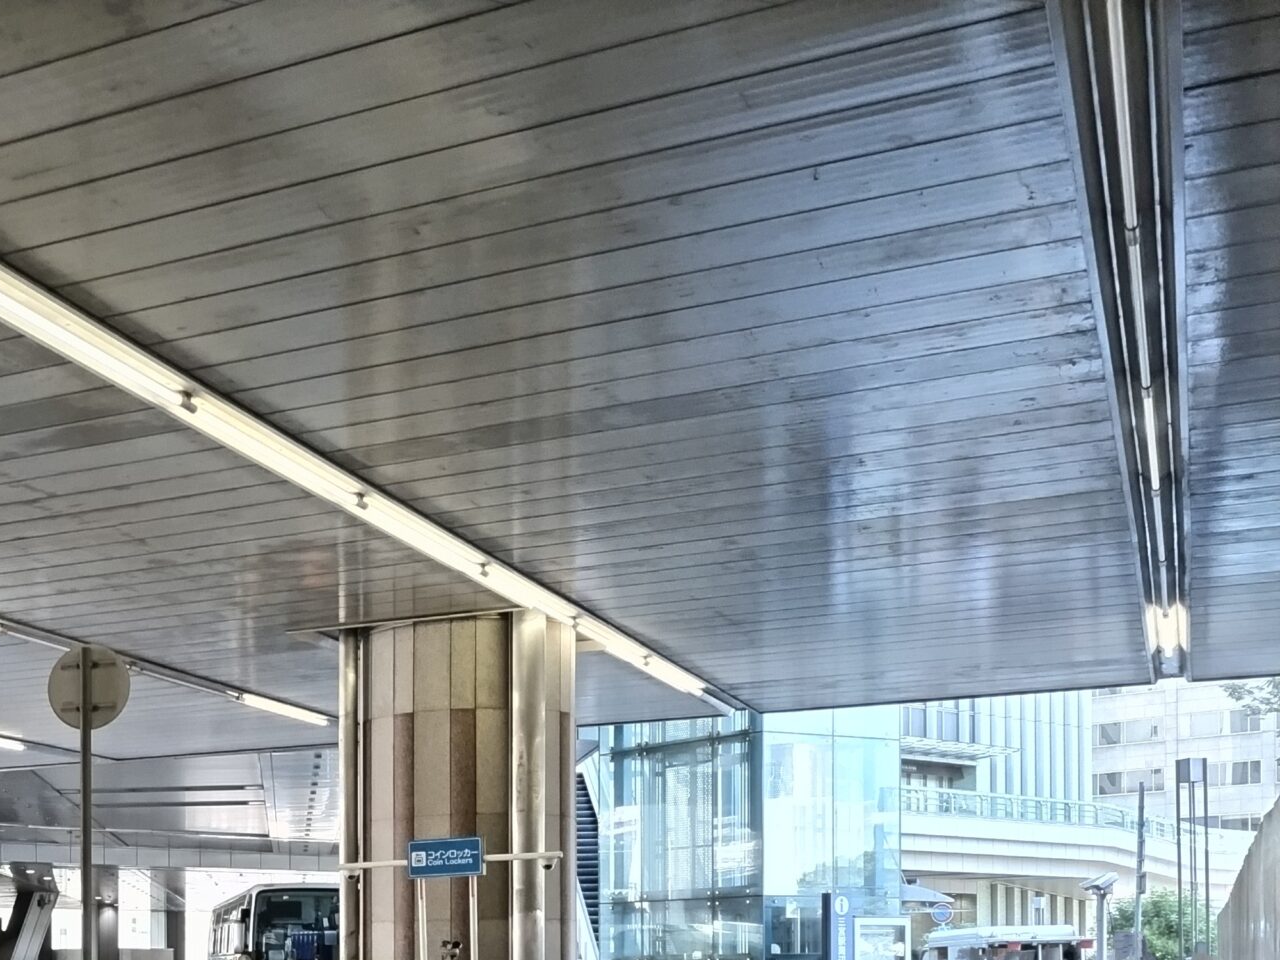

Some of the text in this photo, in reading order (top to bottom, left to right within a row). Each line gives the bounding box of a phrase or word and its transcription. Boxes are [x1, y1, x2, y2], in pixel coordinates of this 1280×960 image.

[427, 848, 478, 859] コインロッカー
[427, 857, 473, 866] Coin Lockers
